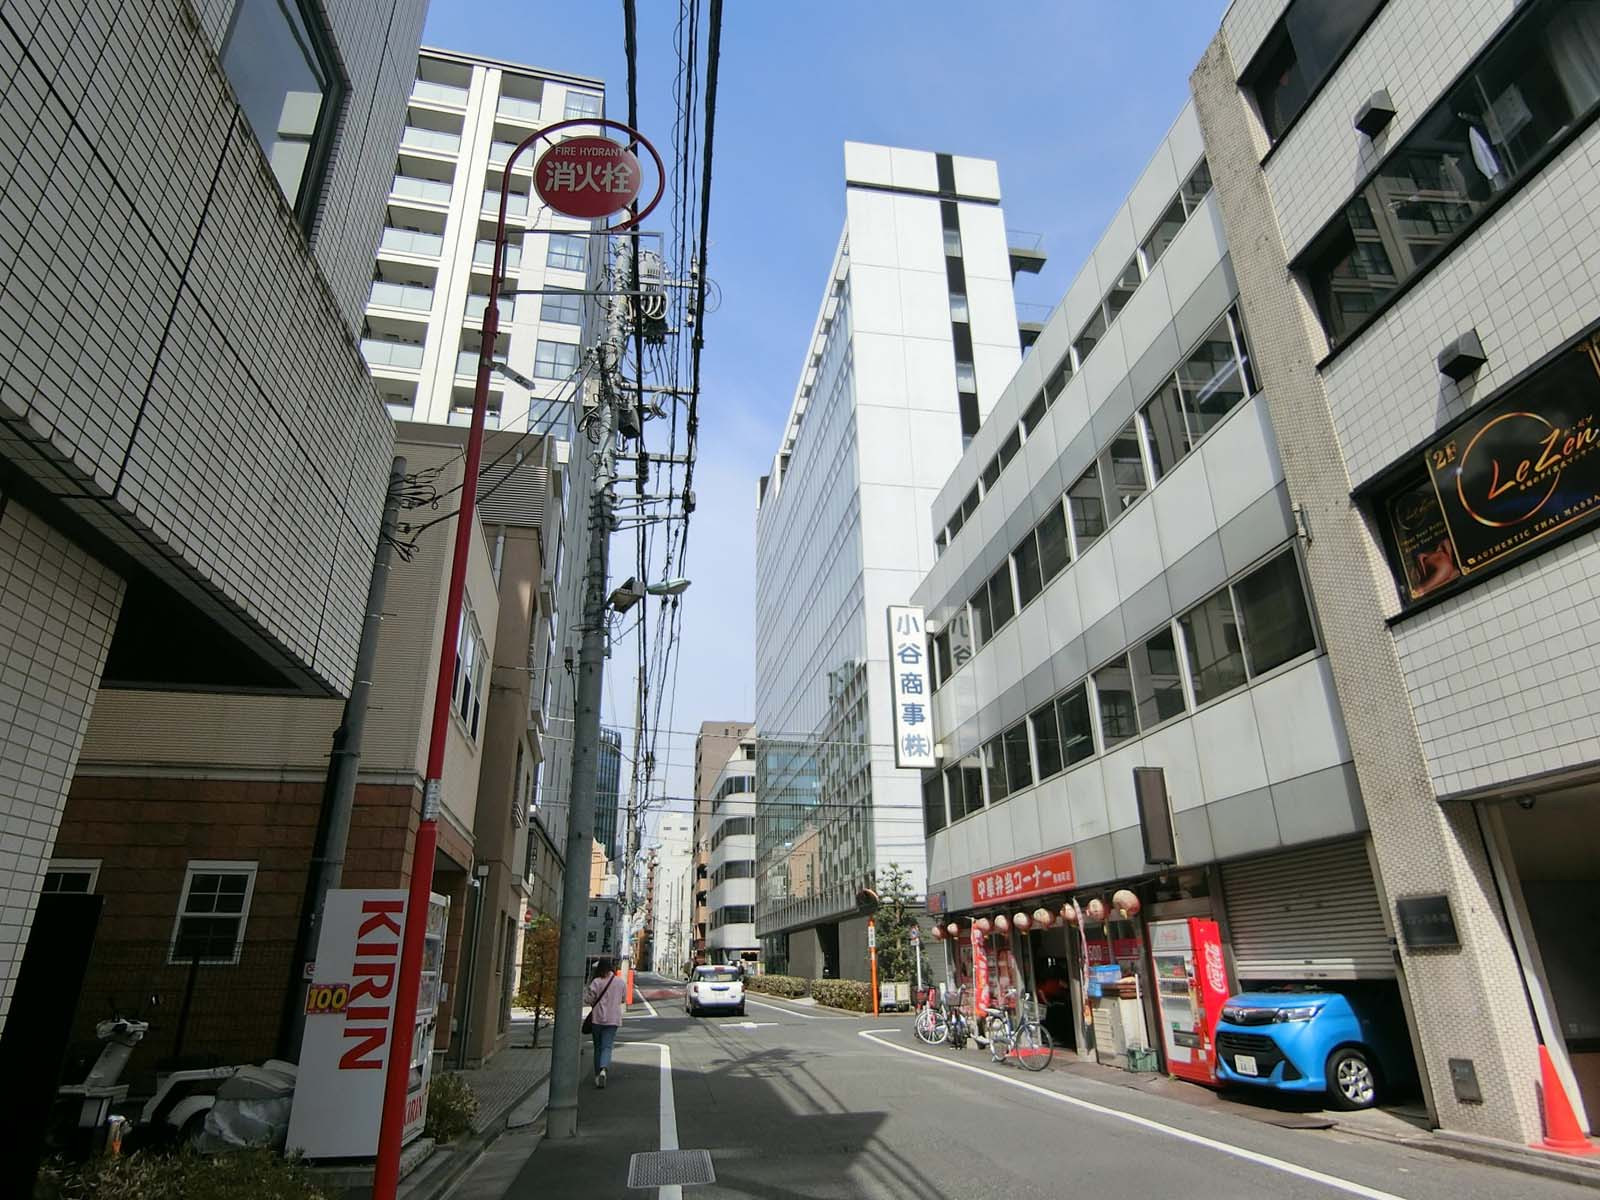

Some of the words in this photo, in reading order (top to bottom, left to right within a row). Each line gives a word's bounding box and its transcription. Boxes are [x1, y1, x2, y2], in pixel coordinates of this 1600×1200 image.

[555, 146, 577, 157] FIRE
[579, 147, 625, 157] HYDRANT
[544, 160, 633, 193] 消火栓
[1433, 439, 1457, 470] 2F
[1477, 529, 1531, 562] AUTHENTIC
[1533, 514, 1561, 532] THAI
[976, 863, 1053, 900] 中華弁当コーナー
[308, 988, 348, 1010] 100
[338, 900, 405, 1070] KIRIN
